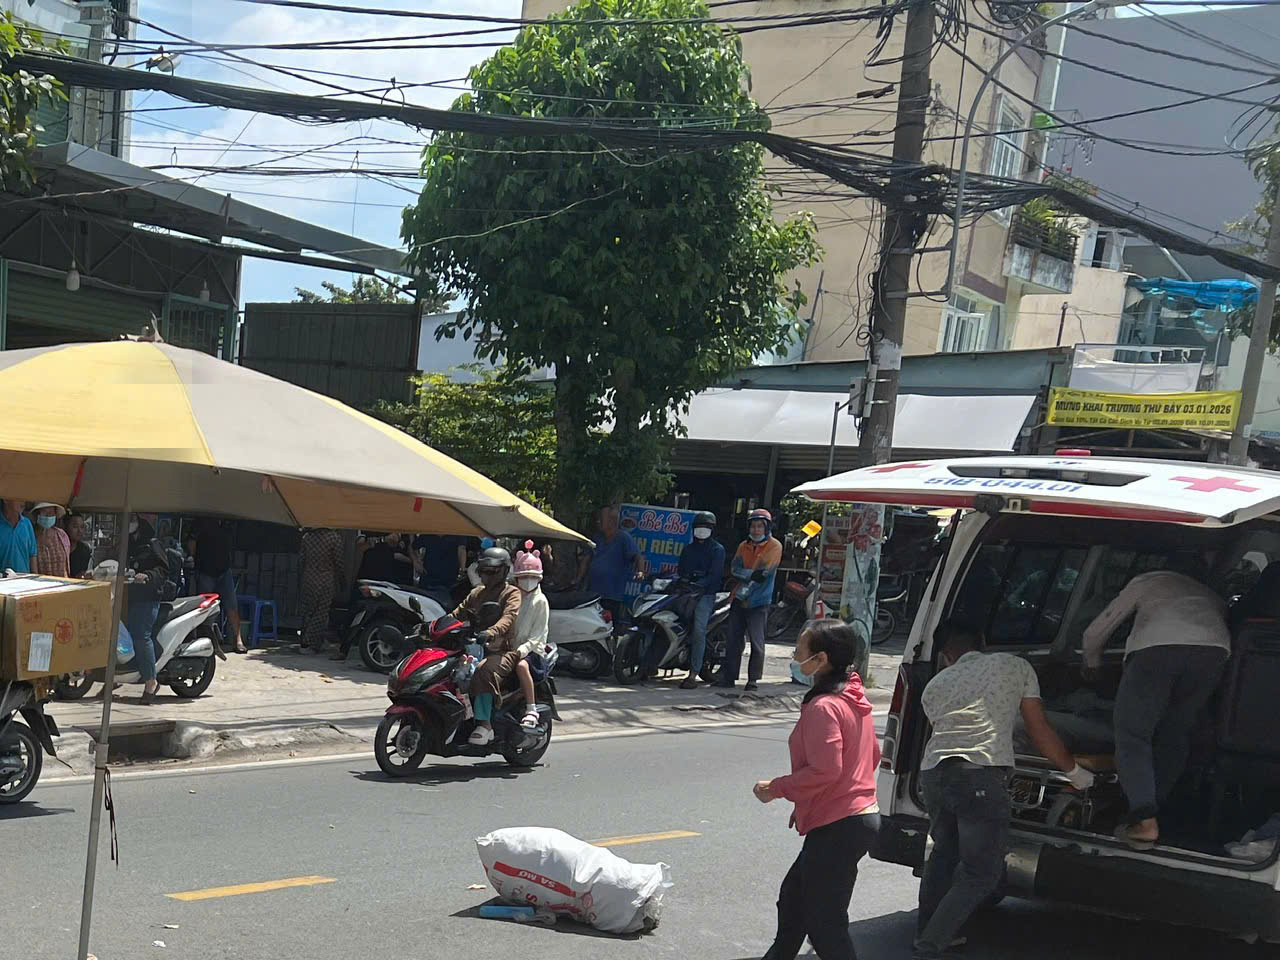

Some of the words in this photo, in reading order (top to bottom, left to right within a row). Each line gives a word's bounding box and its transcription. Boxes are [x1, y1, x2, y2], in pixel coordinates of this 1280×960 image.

[1083, 401, 1104, 412] KHAI
[1183, 404, 1232, 414] 03.01.2026
[639, 509, 664, 532] Bé
